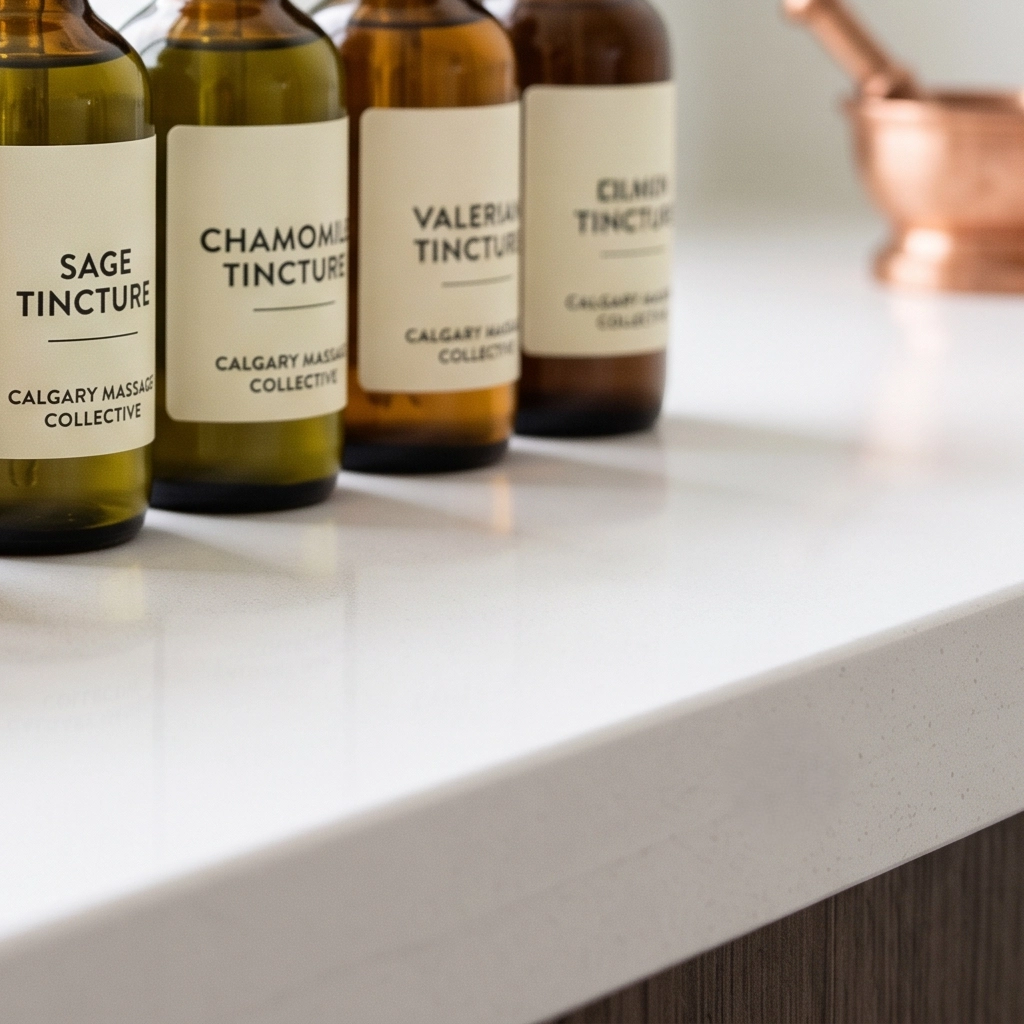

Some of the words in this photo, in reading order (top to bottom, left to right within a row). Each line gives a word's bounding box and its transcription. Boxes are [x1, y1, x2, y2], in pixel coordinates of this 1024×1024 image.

[60, 248, 132, 280] SAGE
[223, 253, 346, 287] TINCTURE
[16, 280, 150, 317] TINCTURE
[404, 326, 482, 344] CALGARY
[215, 353, 299, 371] CALGARY
[8, 386, 98, 405] CALGARY
[101, 374, 154, 402] MASSAGE
[249, 368, 338, 393] COLLECTIVE
[44, 402, 141, 428] COLLECTIVE
